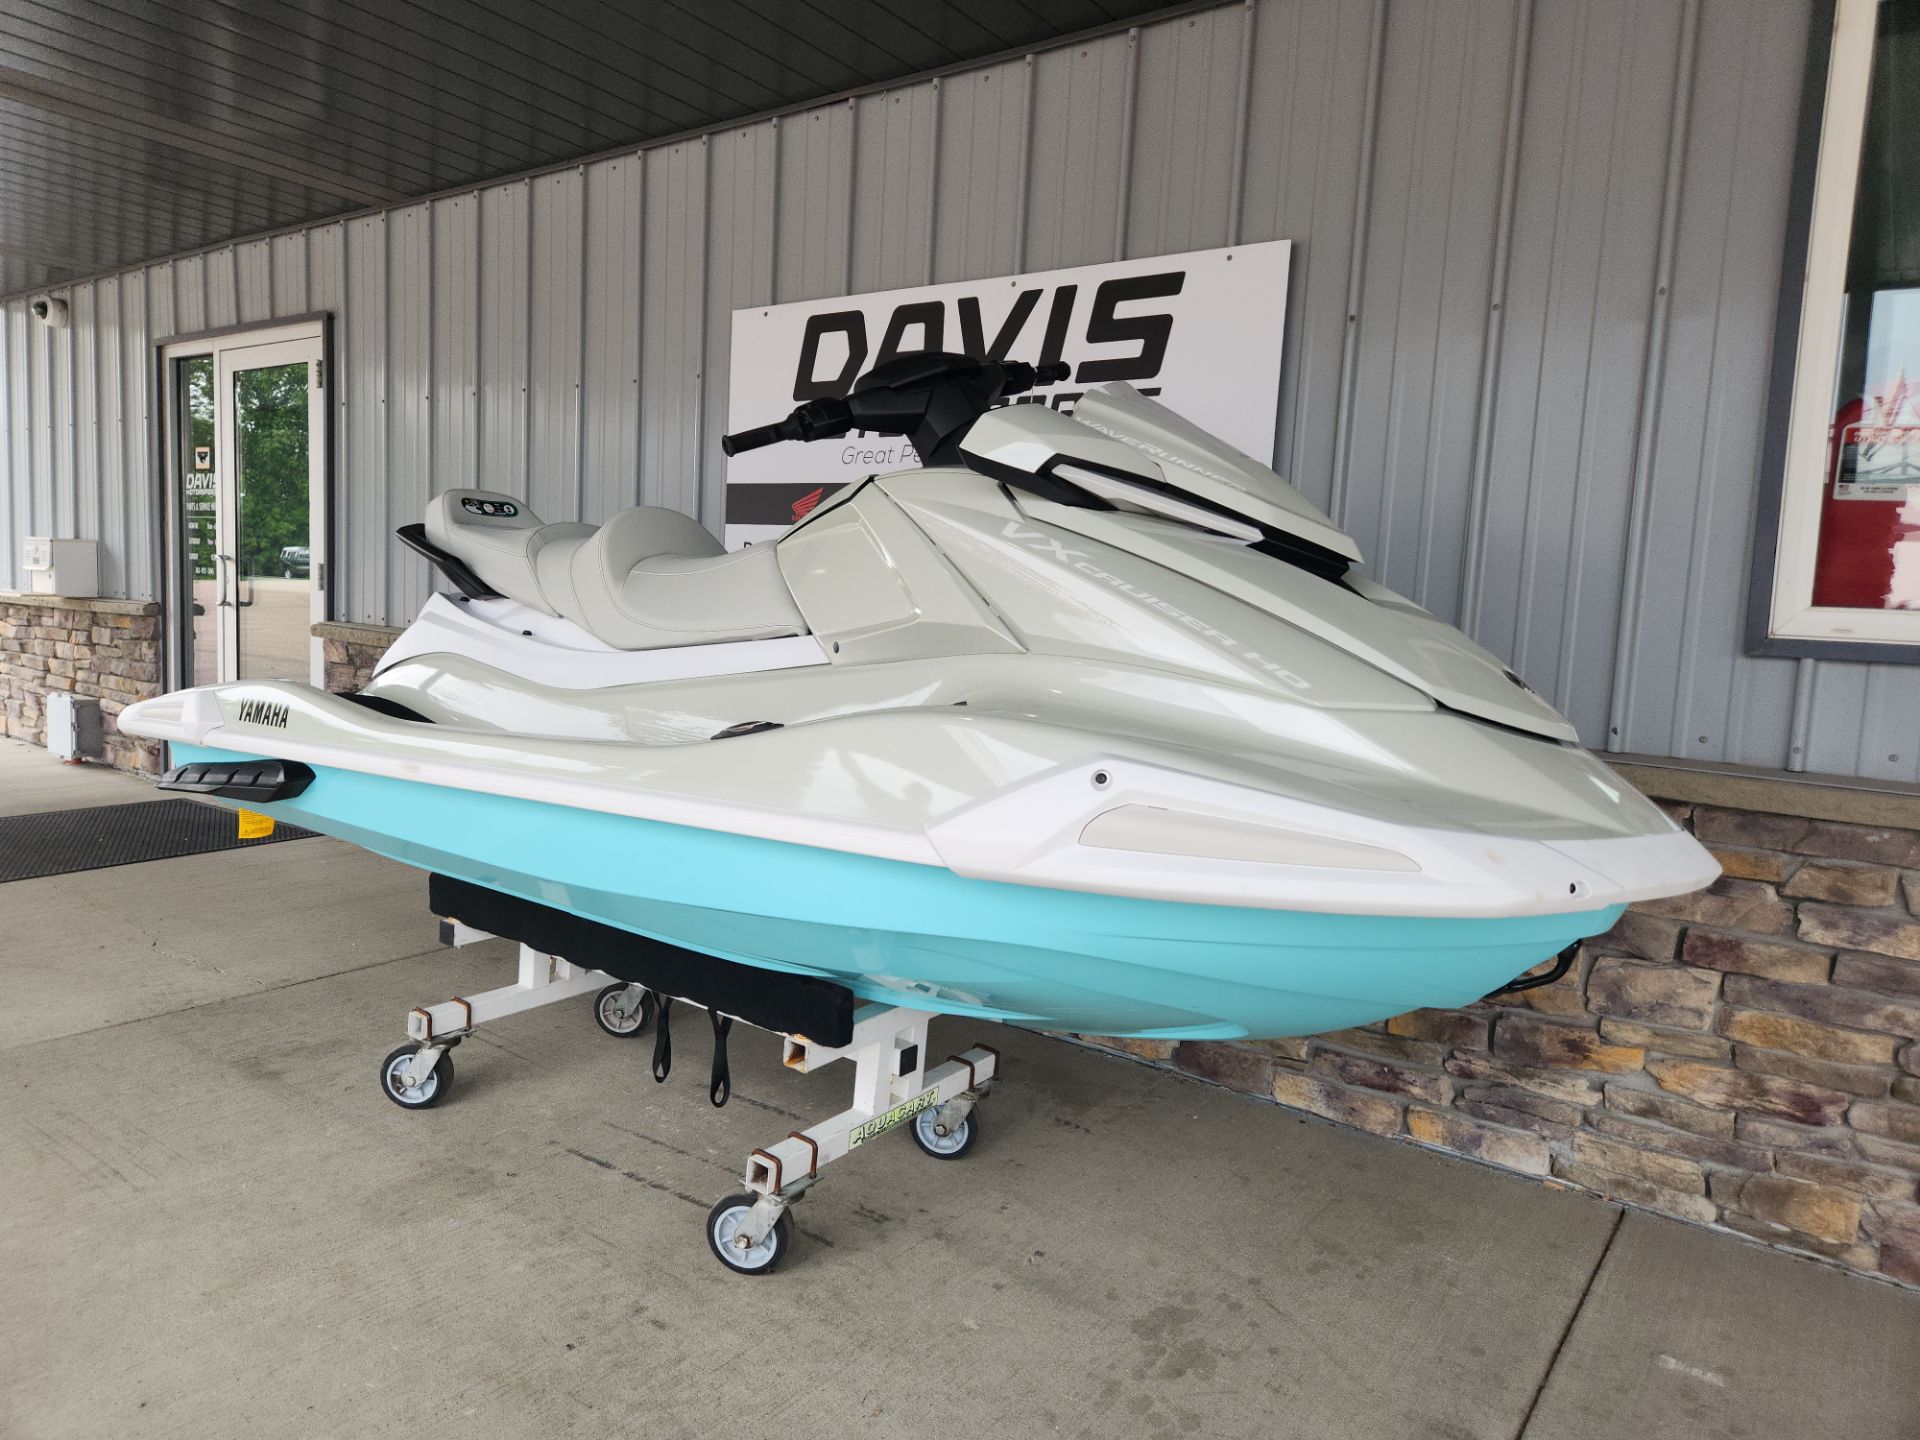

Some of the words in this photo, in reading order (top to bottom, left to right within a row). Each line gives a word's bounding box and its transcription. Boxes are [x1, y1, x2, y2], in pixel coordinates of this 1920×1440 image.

[793, 271, 1186, 401] DAVIS
[841, 445, 893, 465] Great
[1002, 521, 1092, 563] VX
[1073, 561, 1238, 647] CRUISER
[238, 699, 290, 729] YAMAHA
